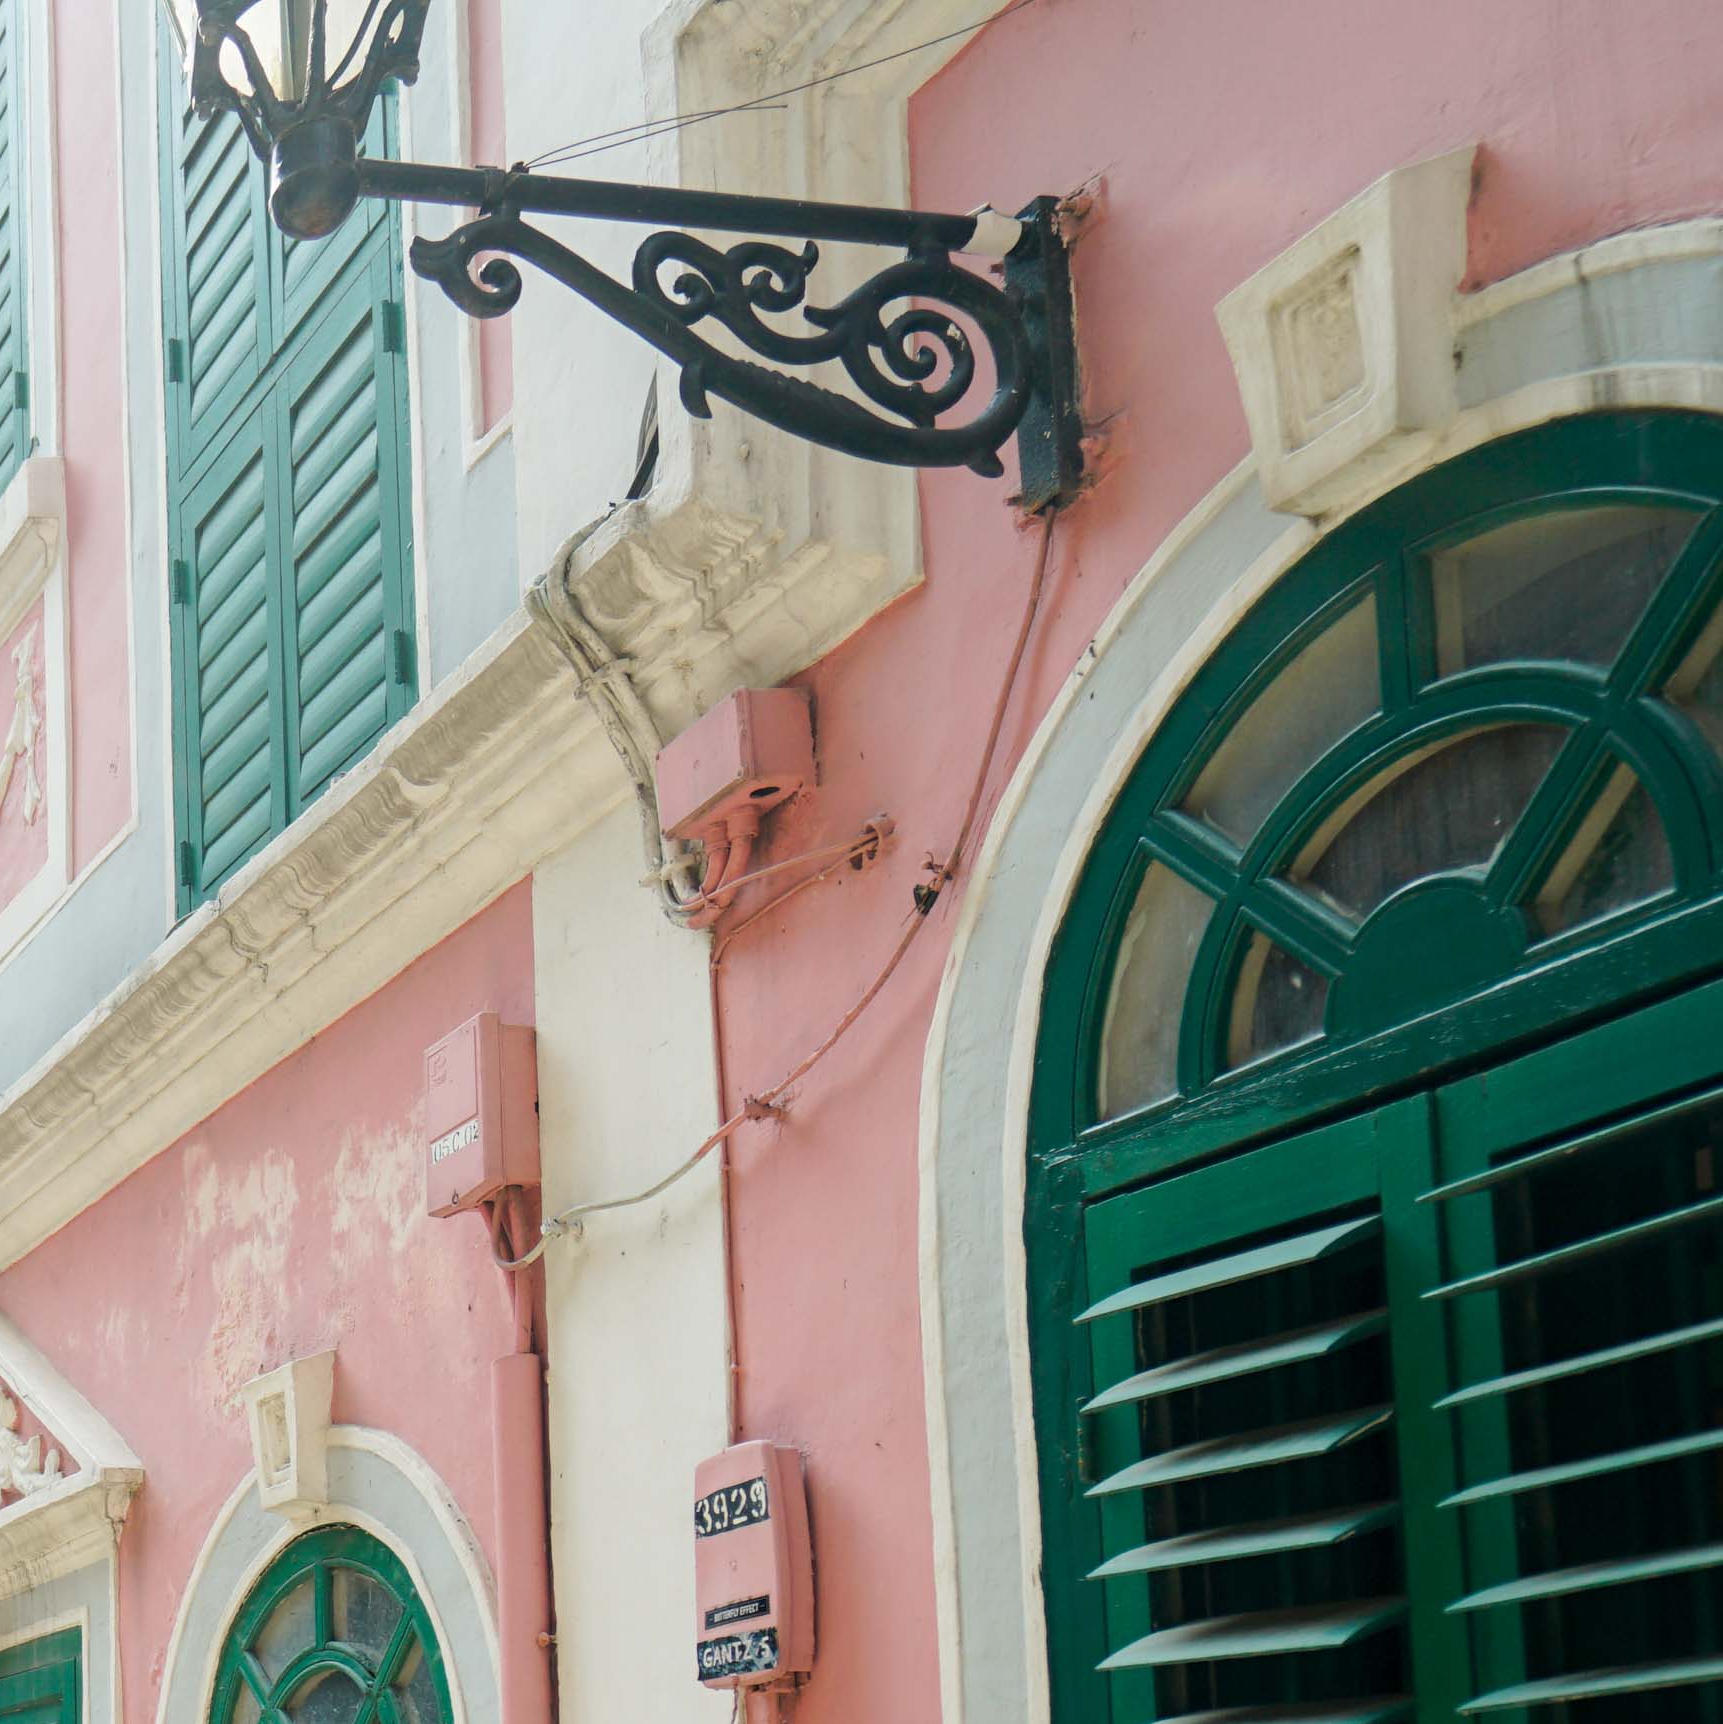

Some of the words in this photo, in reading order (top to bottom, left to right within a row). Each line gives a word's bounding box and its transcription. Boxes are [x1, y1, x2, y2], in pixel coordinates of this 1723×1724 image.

[695, 1480, 768, 1535] 3929
[713, 1607, 739, 1623] BUTTERFLY
[739, 1602, 760, 1619] EFFECT
[703, 1639, 752, 1668] GANTZ
